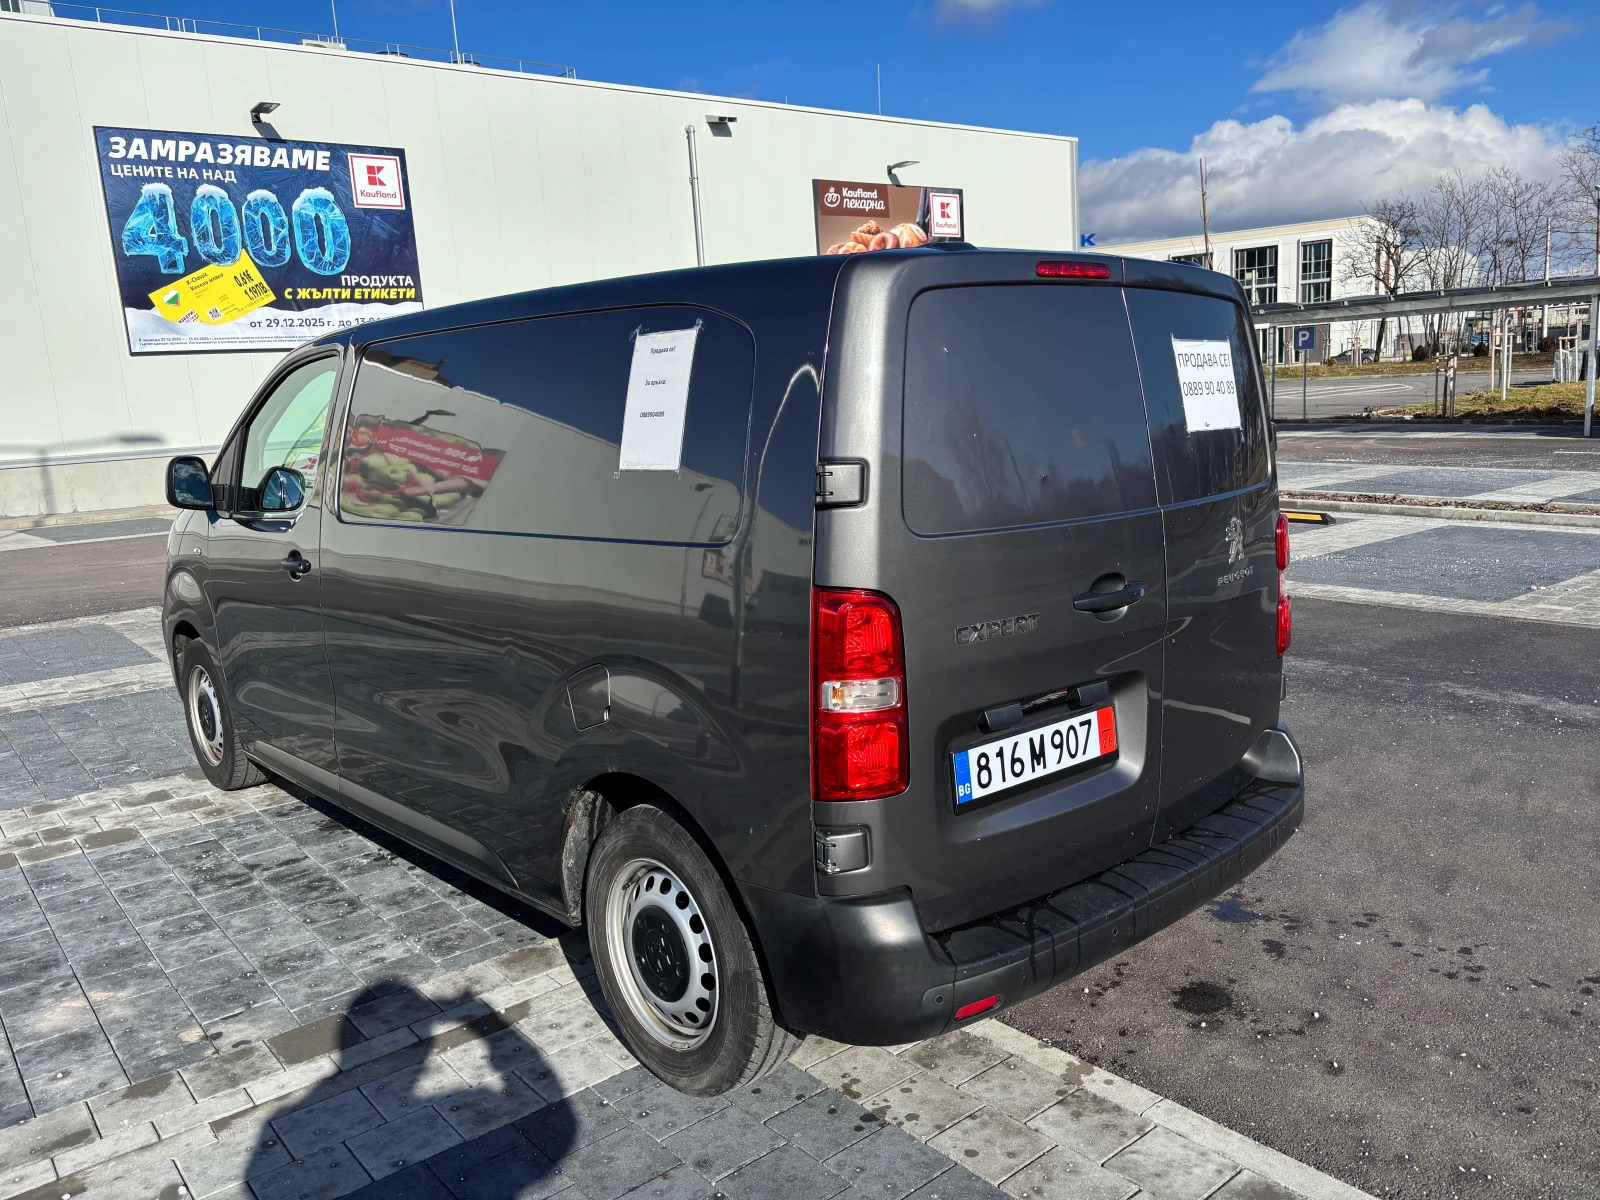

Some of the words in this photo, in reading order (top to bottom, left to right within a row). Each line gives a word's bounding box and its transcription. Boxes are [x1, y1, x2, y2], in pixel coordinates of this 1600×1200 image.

[108, 137, 331, 171] ЗАМРАЗЯВАМЕ
[110, 164, 173, 178] ЦЕНИТЕ
[177, 168, 199, 179] НА
[203, 169, 237, 183] НАД
[360, 190, 397, 199] Kaufland
[842, 187, 878, 199] Kaufland
[843, 198, 885, 212] пекарна
[121, 183, 351, 275] 4000
[935, 221, 957, 229] Kaufland
[233, 269, 254, 287] 0.61€
[341, 275, 414, 288] ПРОДУКТА
[284, 288, 293, 299] С
[296, 288, 351, 299] ЖЪЛТИ
[354, 288, 416, 299] ЕТИКЕТИ
[265, 318, 325, 328] 29.12.2025
[338, 320, 352, 328] до
[1298, 331, 1310, 347] P
[1178, 353, 1218, 370] ПРОДАВА
[1219, 353, 1231, 367] СЕ!
[1183, 381, 1204, 396] 0889
[1205, 381, 1215, 395] 90
[1216, 381, 1226, 395] 40
[1226, 380, 1235, 395] 89
[1218, 566, 1255, 586] PEUGEOT
[955, 611, 1040, 645] EXPERT
[1102, 737, 1113, 749] 26
[958, 782, 971, 797] BG
